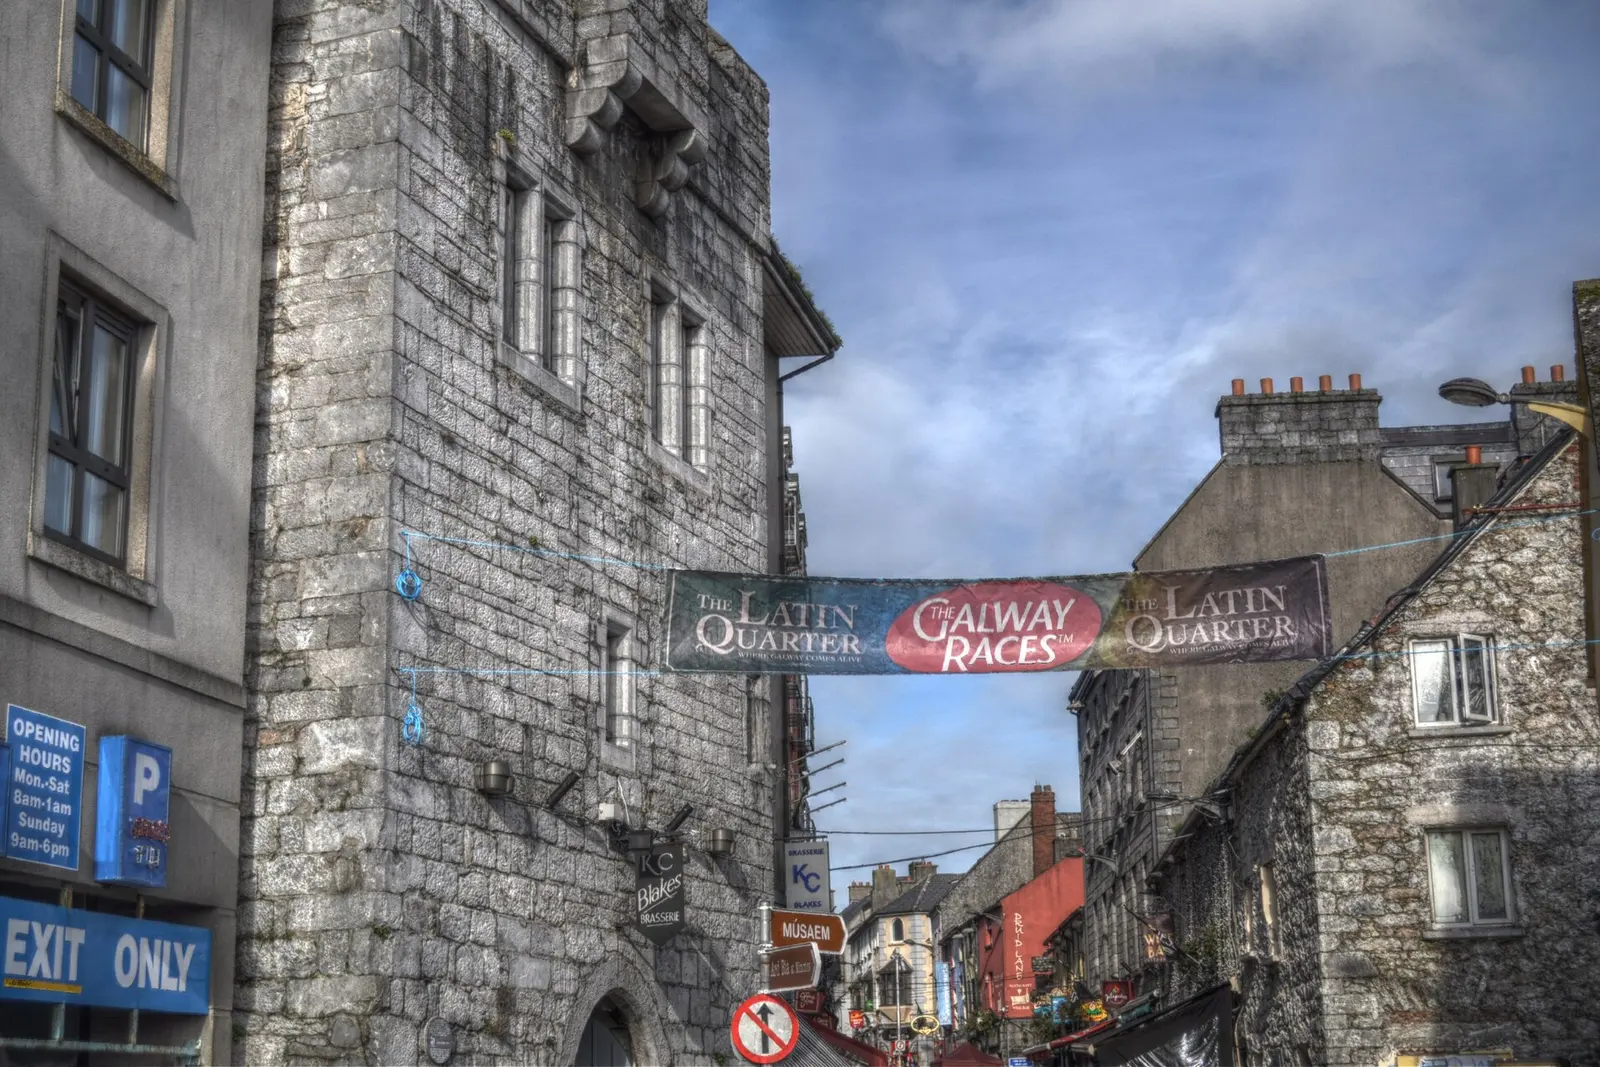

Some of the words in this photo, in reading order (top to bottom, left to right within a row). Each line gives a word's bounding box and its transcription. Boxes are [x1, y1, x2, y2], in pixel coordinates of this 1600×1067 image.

[697, 594, 732, 611] THE
[735, 589, 858, 630] LATIN
[913, 597, 1076, 642] GALWAY
[930, 606, 956, 620] THE
[1125, 597, 1158, 612] THE
[1162, 585, 1287, 621] LATIN
[696, 614, 865, 655] QUARTER
[1125, 614, 1298, 655] QUARTER
[941, 634, 1057, 672] RACES
[13, 717, 80, 752] OPENING
[19, 745, 71, 774] HOURS
[133, 752, 161, 805] P
[13, 790, 72, 816] 8am-1am
[18, 812, 65, 838] Sunday
[10, 832, 70, 858] 9am-6pm
[788, 848, 824, 857] BRASSERIE
[638, 873, 682, 912] Blakes
[792, 863, 821, 893] KC
[640, 911, 680, 924] BRASSERIE
[793, 900, 822, 909] BLAKES
[782, 918, 831, 941] MÚSAEM
[1014, 912, 1024, 947] DRUID
[4, 918, 86, 981] EXIT
[114, 933, 196, 992] ONLY
[1014, 950, 1024, 981] LANE
